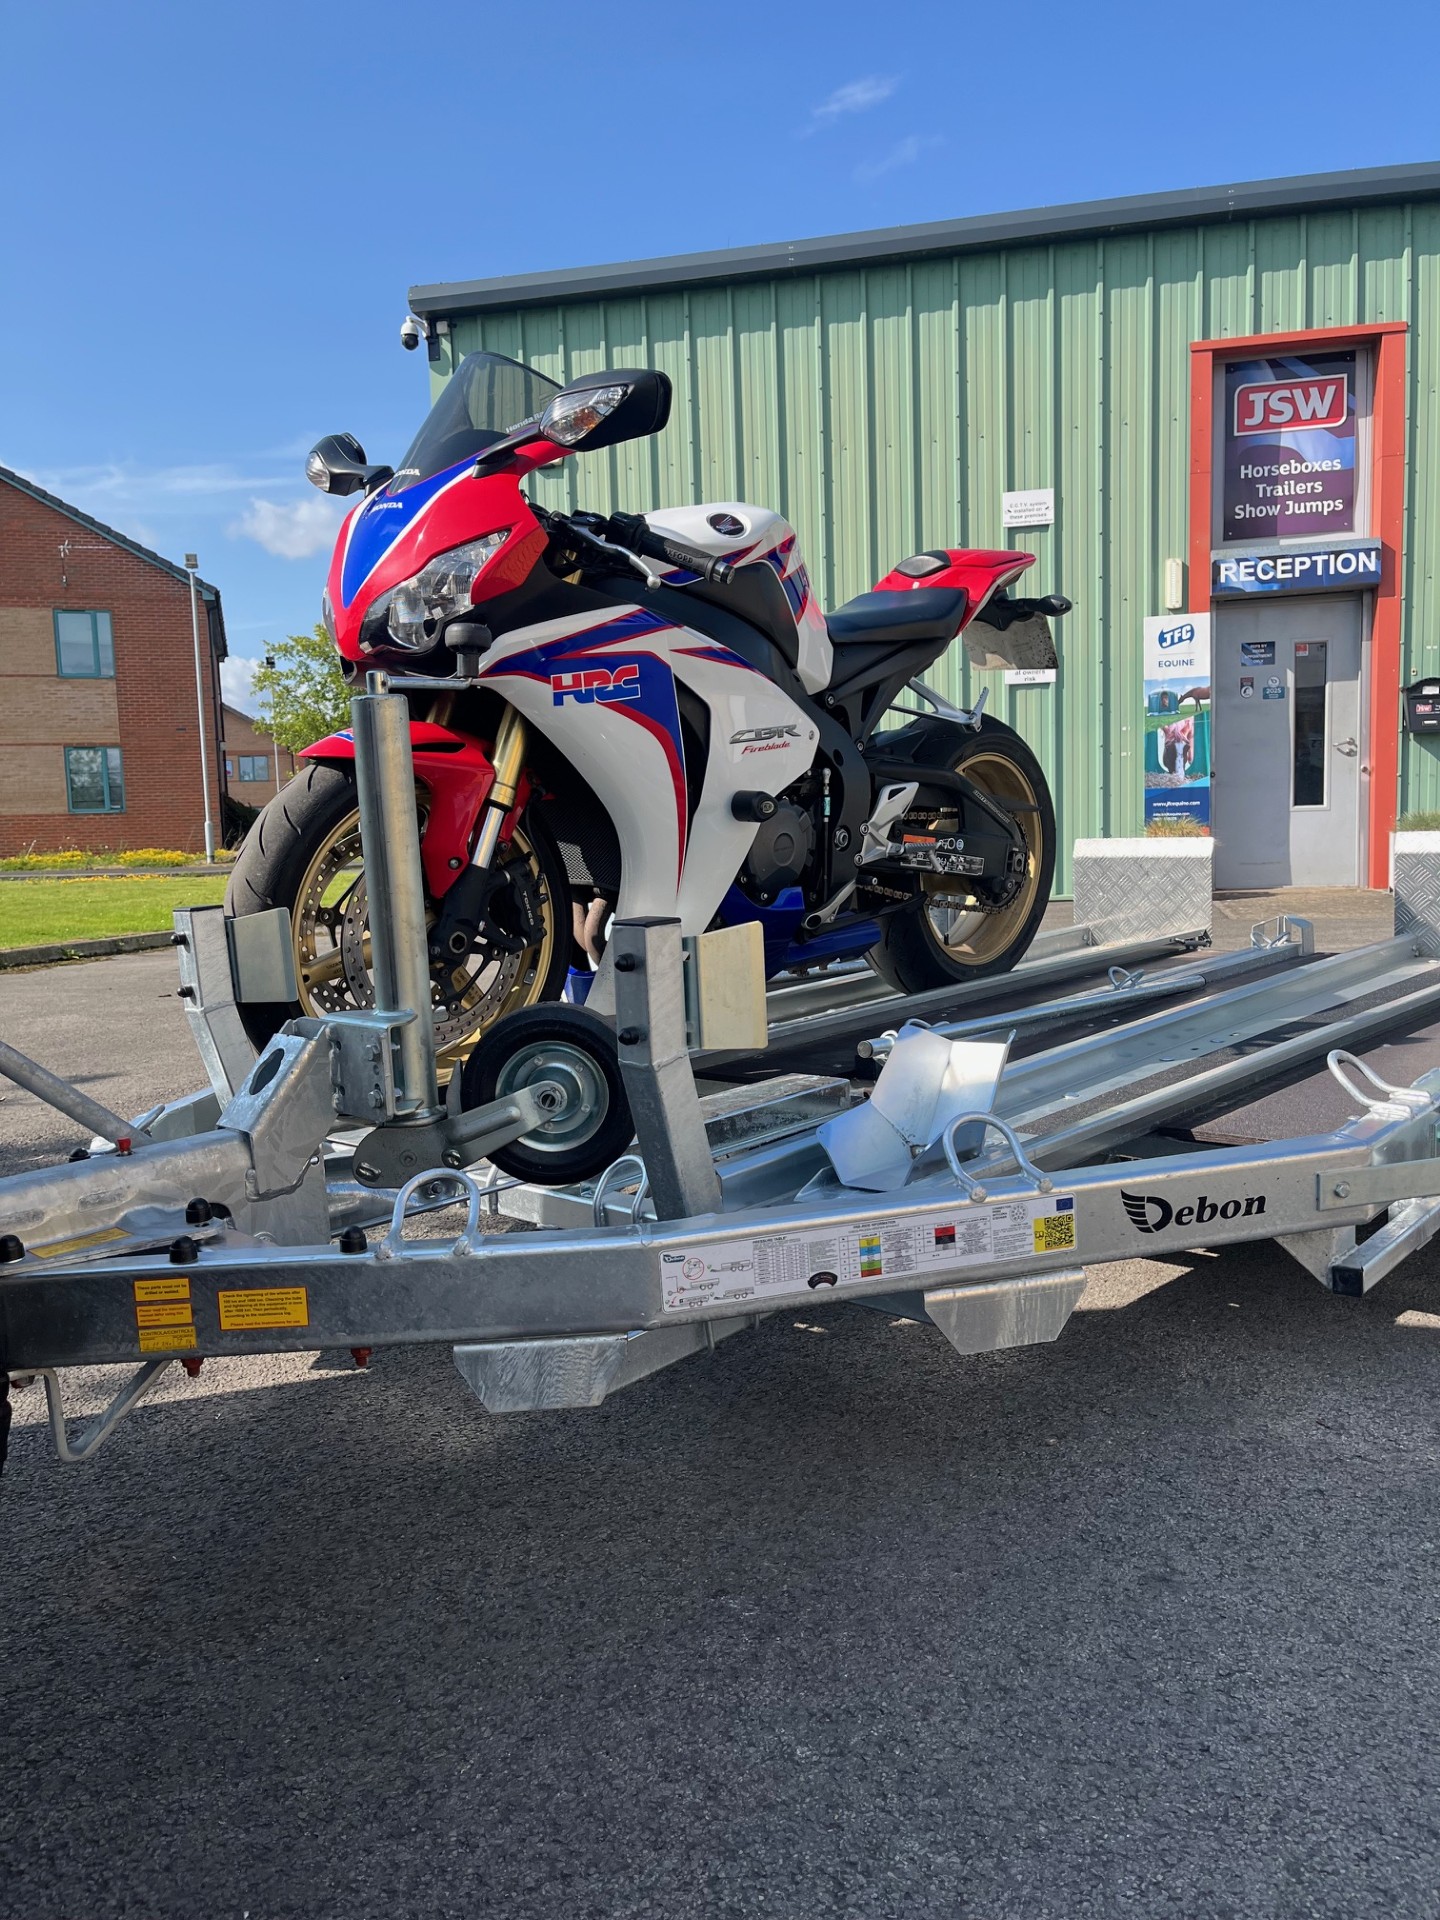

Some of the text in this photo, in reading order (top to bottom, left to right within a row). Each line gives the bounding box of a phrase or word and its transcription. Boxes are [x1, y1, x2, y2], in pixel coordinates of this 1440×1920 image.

[1244, 385, 1336, 426] JSW
[506, 416, 534, 433] Honda
[1240, 458, 1342, 479] Horseboxes
[1256, 480, 1323, 498] Trailers
[1234, 498, 1344, 520] Show Jumps
[1220, 551, 1377, 584] RECEPTION
[1161, 625, 1192, 648] JFC
[1158, 658, 1196, 668] EQUINE
[551, 664, 641, 707] HRC
[729, 724, 801, 744] CBR
[741, 741, 791, 755] Fireblade
[522, 890, 535, 926] TOKICO
[1121, 1188, 1267, 1234] Debon
